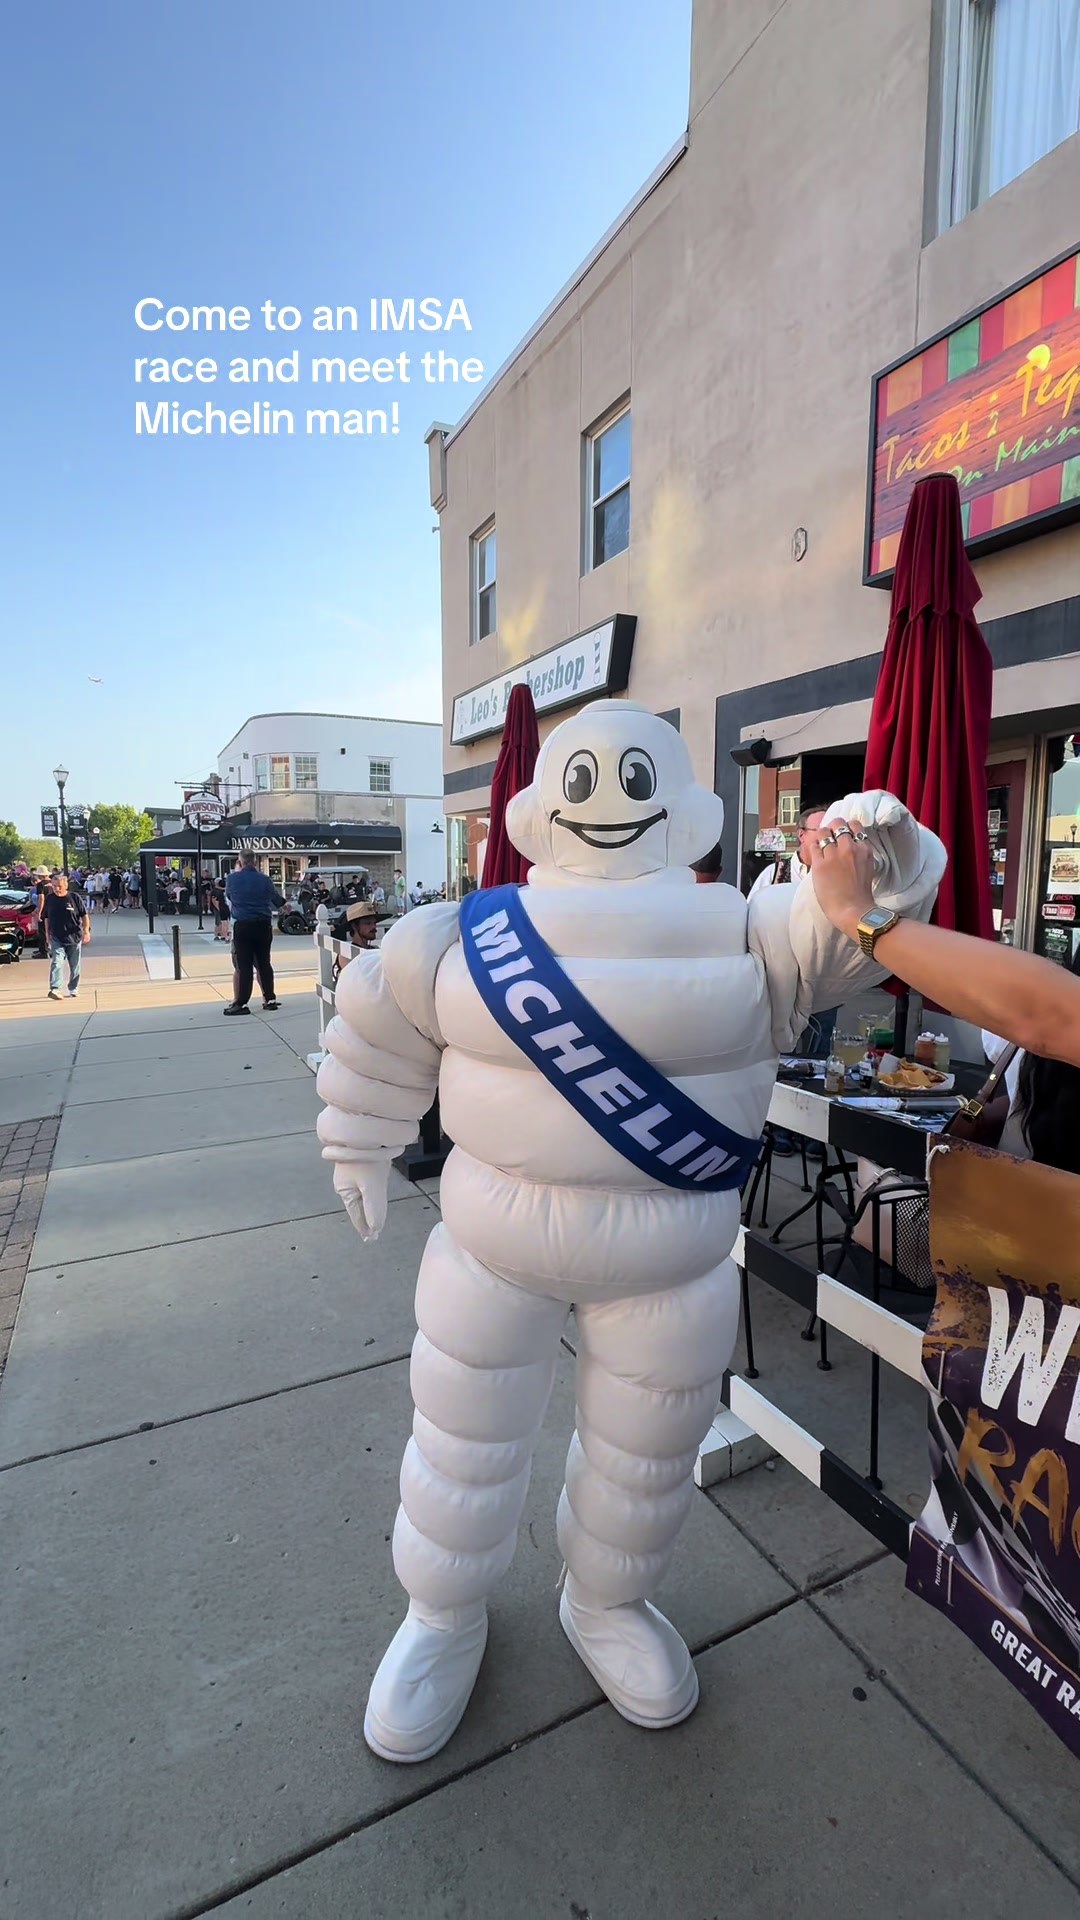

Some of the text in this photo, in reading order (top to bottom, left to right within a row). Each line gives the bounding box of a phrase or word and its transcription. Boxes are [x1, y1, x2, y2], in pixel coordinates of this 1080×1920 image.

[883, 421, 970, 484] Tacos
[995, 426, 1080, 472] Main
[470, 688, 498, 725] Leo's
[185, 801, 225, 814] DAWSON'S
[231, 836, 296, 849] DAWSON'S
[471, 909, 740, 1182] MICHELIN
[981, 1286, 1080, 1445] W
[957, 1407, 1080, 1557] RA
[991, 1619, 1058, 1689] GREAT
